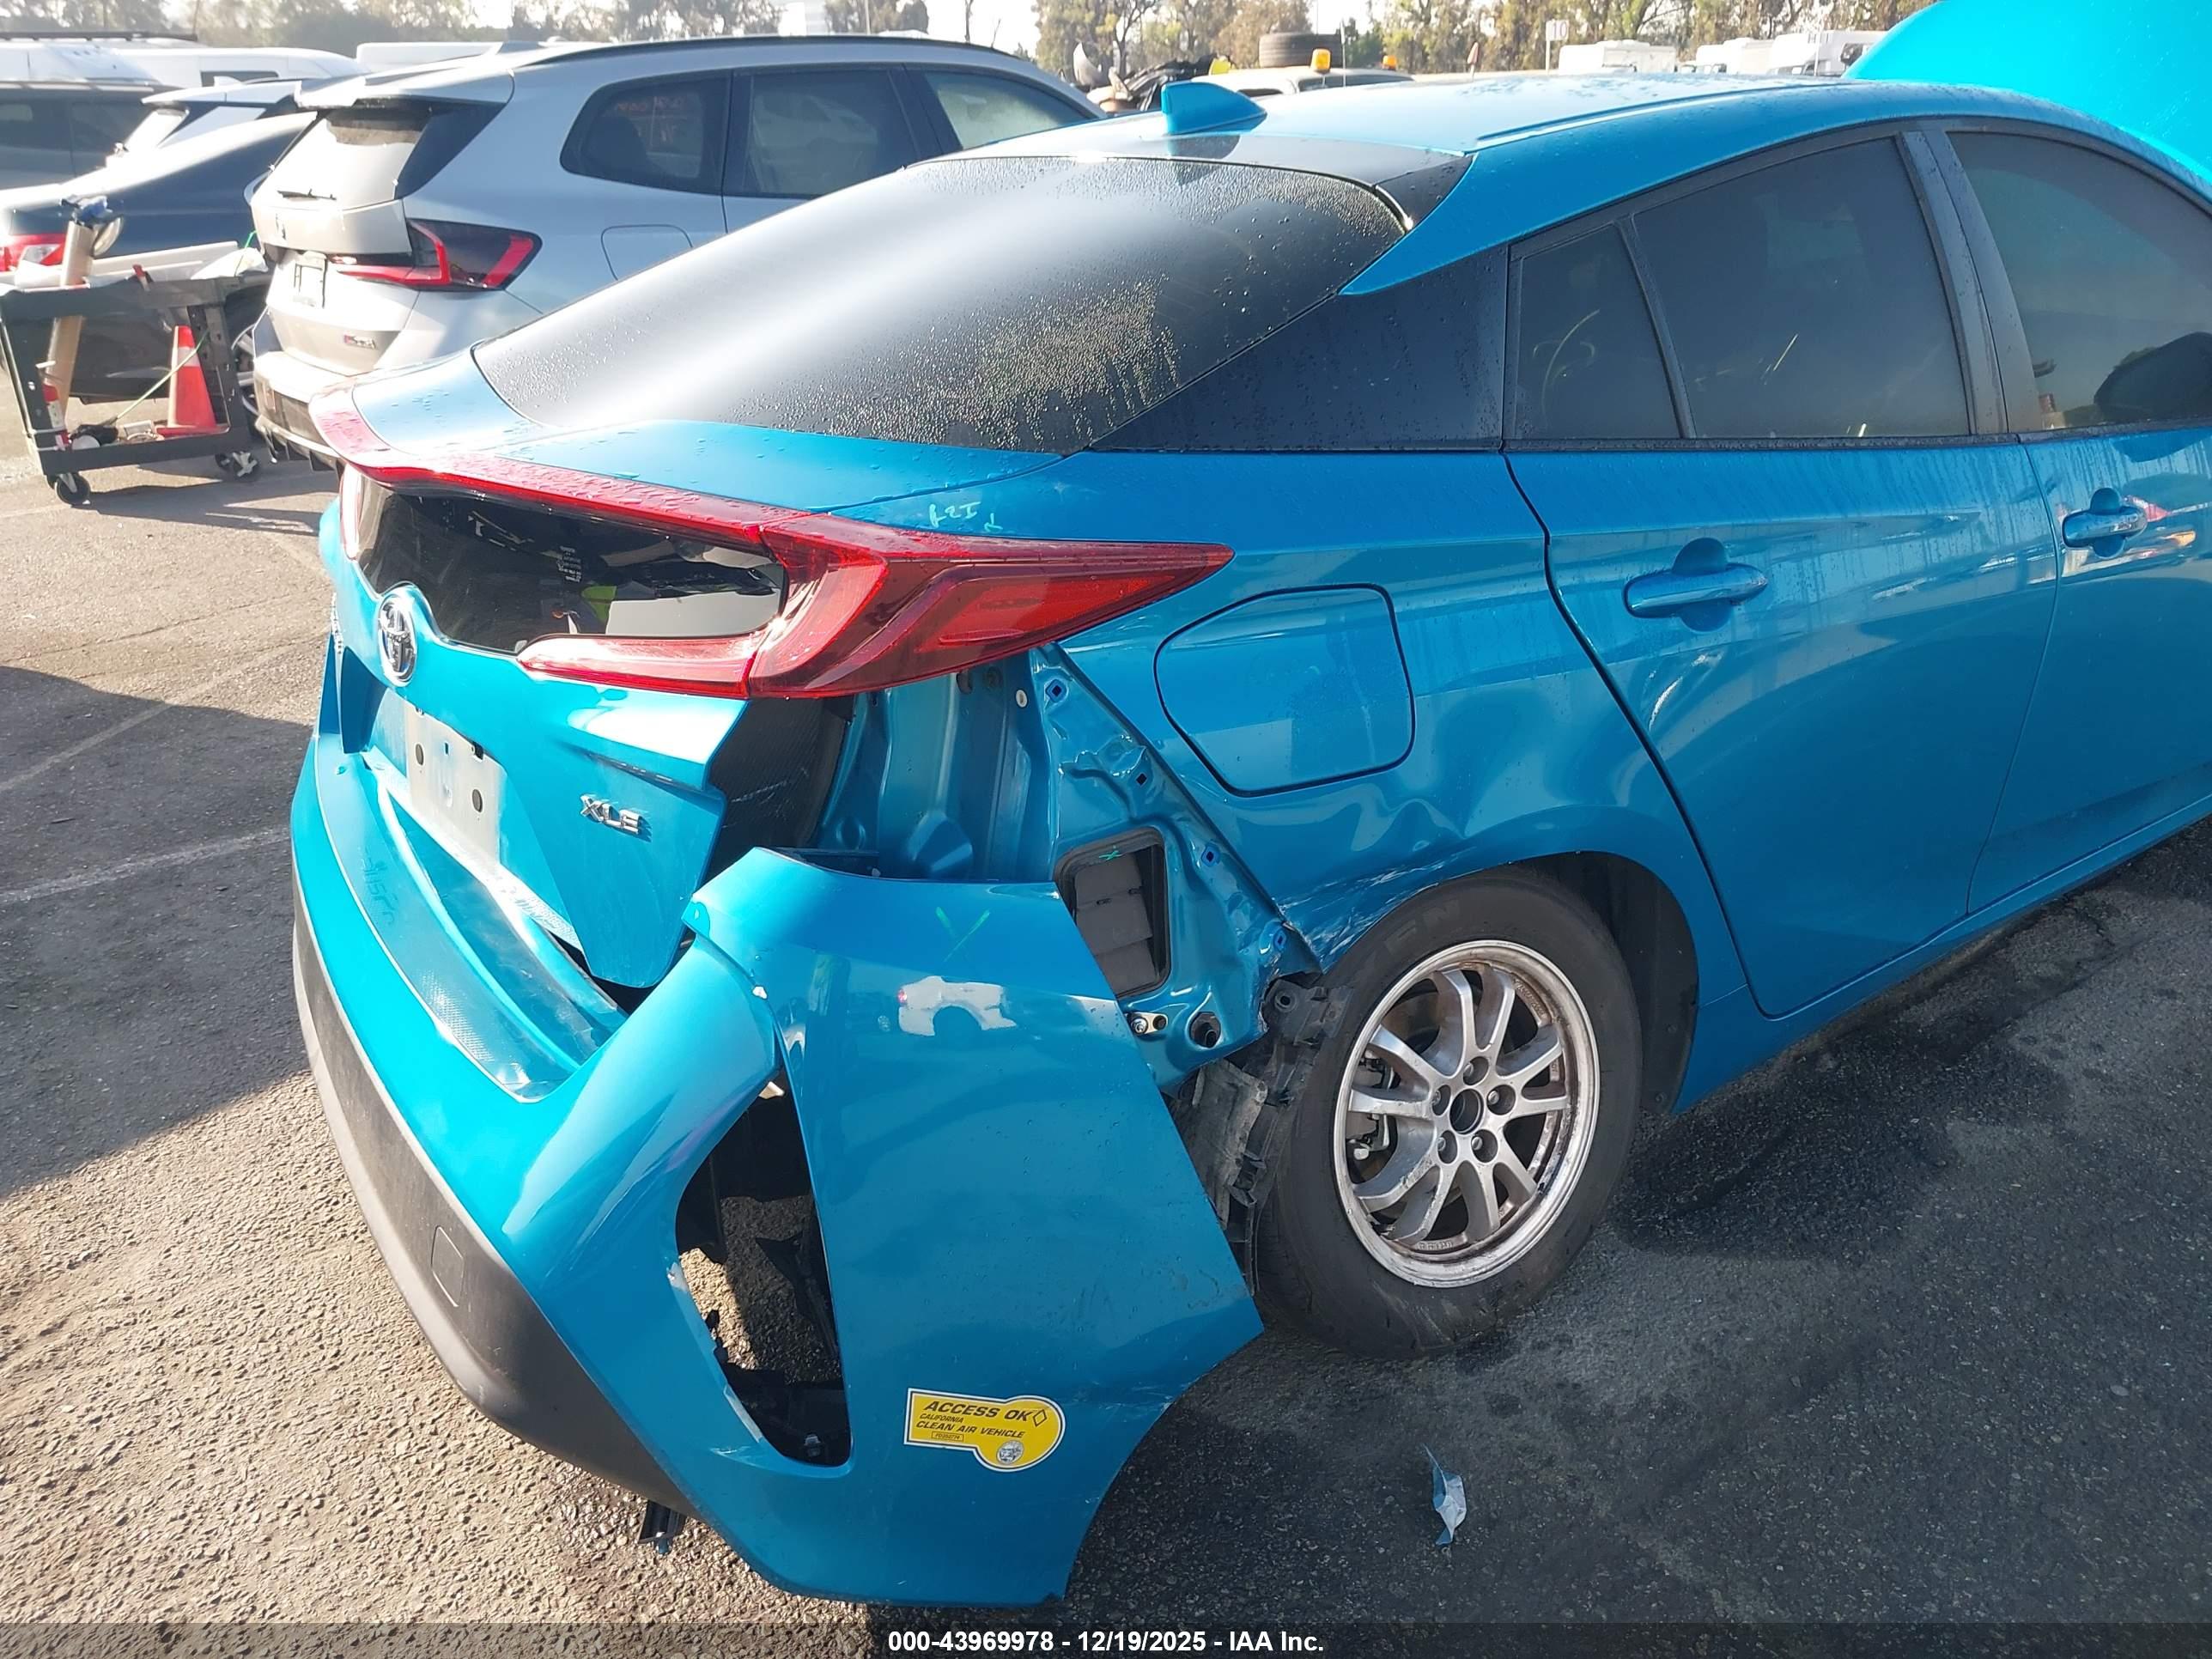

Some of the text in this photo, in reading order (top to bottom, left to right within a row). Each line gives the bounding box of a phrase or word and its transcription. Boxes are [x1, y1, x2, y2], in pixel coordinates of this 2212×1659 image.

[580, 794, 641, 836] XLE
[919, 1413, 964, 1424] CALIFORNIA
[924, 1401, 1033, 1422] ACCESS OK
[916, 1420, 1025, 1438] CLEAN AIR VEHICLE
